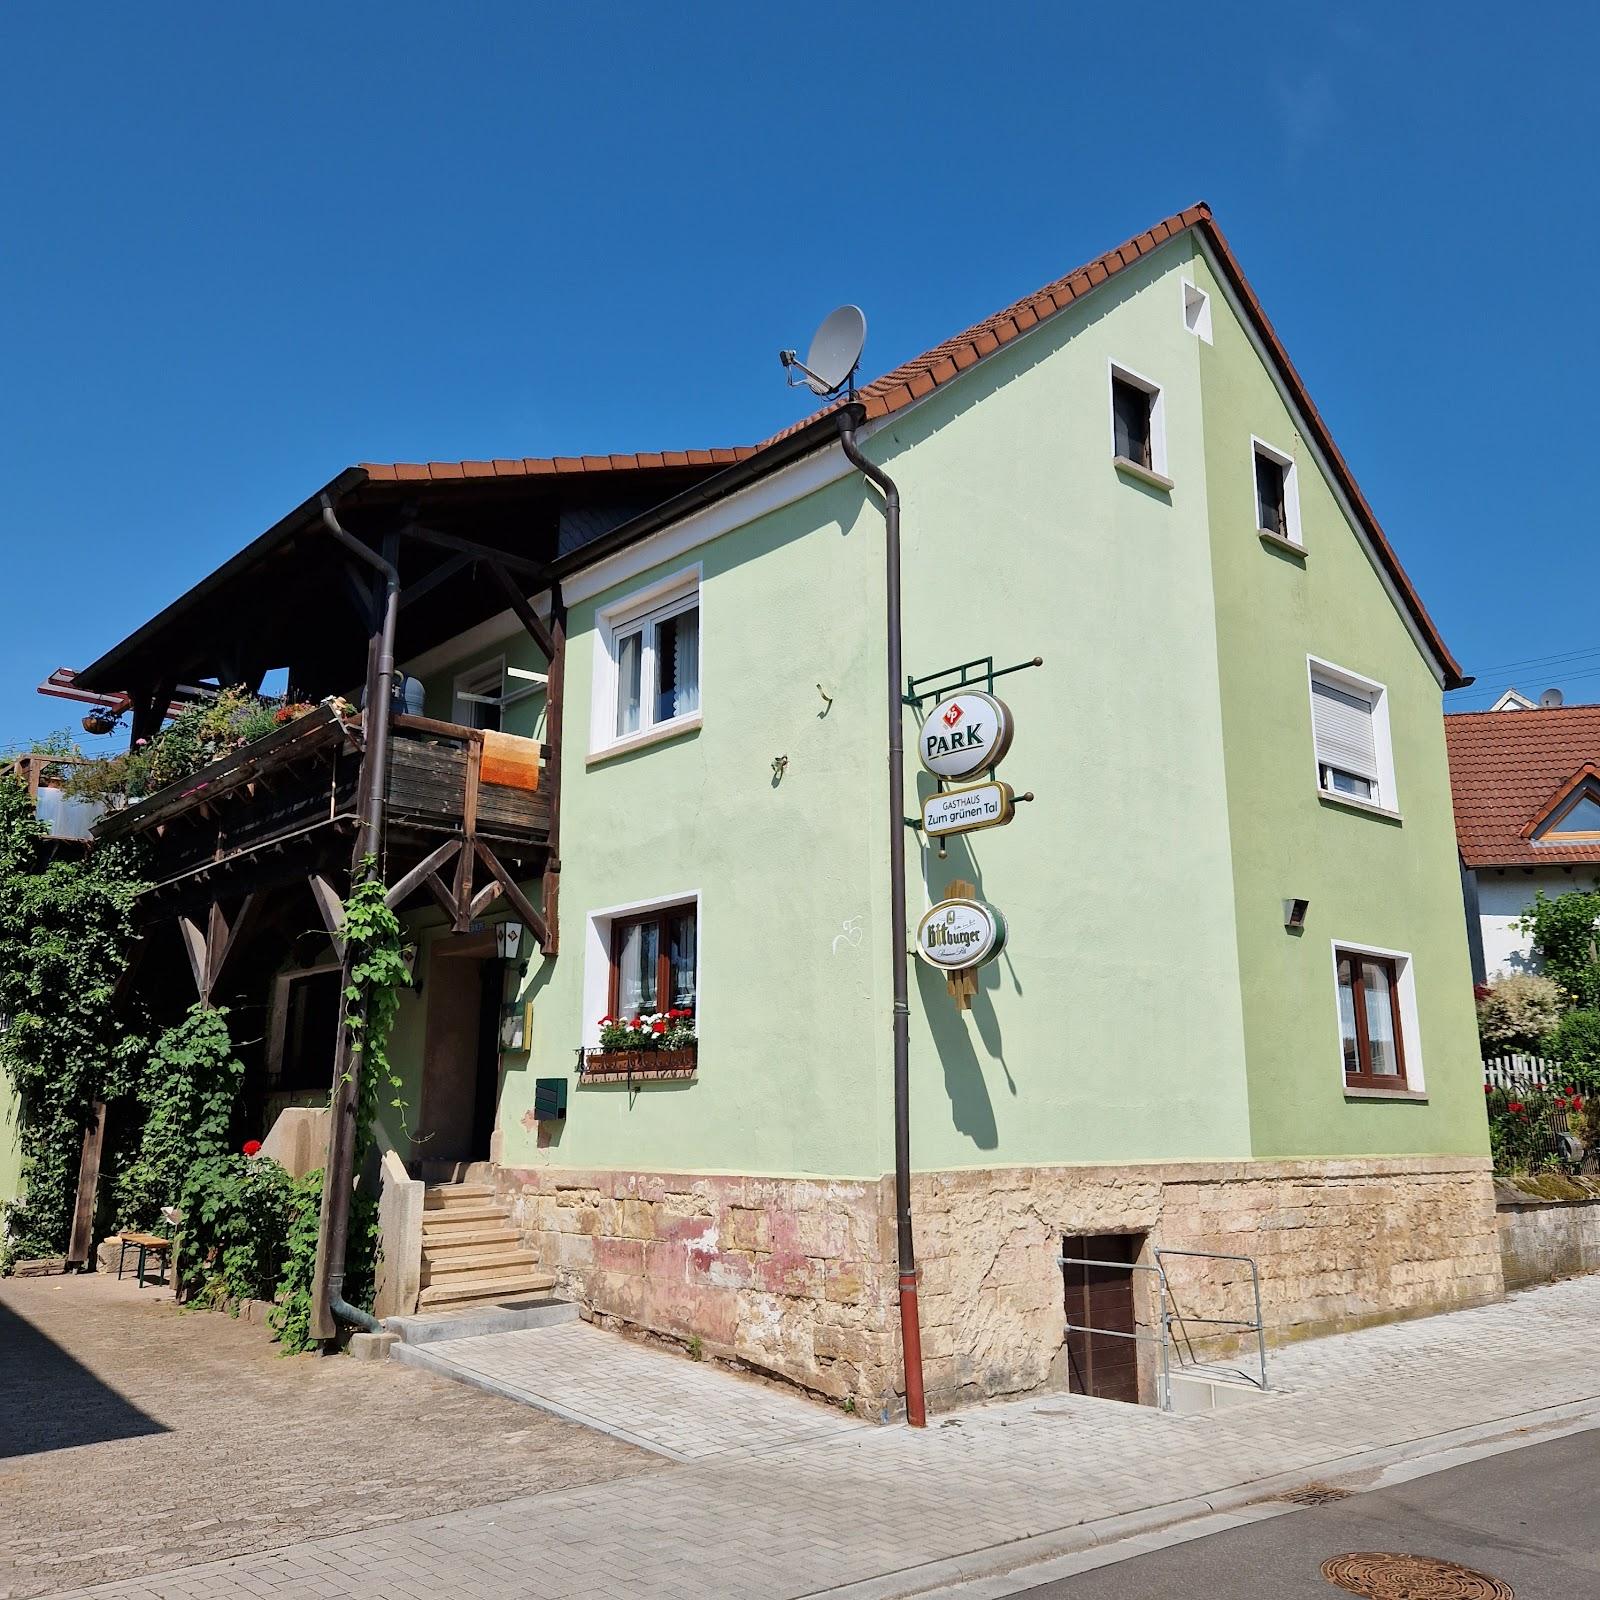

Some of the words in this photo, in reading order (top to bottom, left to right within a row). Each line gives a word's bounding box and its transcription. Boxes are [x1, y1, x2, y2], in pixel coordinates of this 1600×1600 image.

[926, 723, 985, 757] PARK
[927, 814, 948, 826] Zum
[949, 807, 982, 823] grünen
[984, 801, 998, 814] Tal
[942, 795, 981, 811] GASTHAUS
[927, 922, 980, 948] Bitburger
